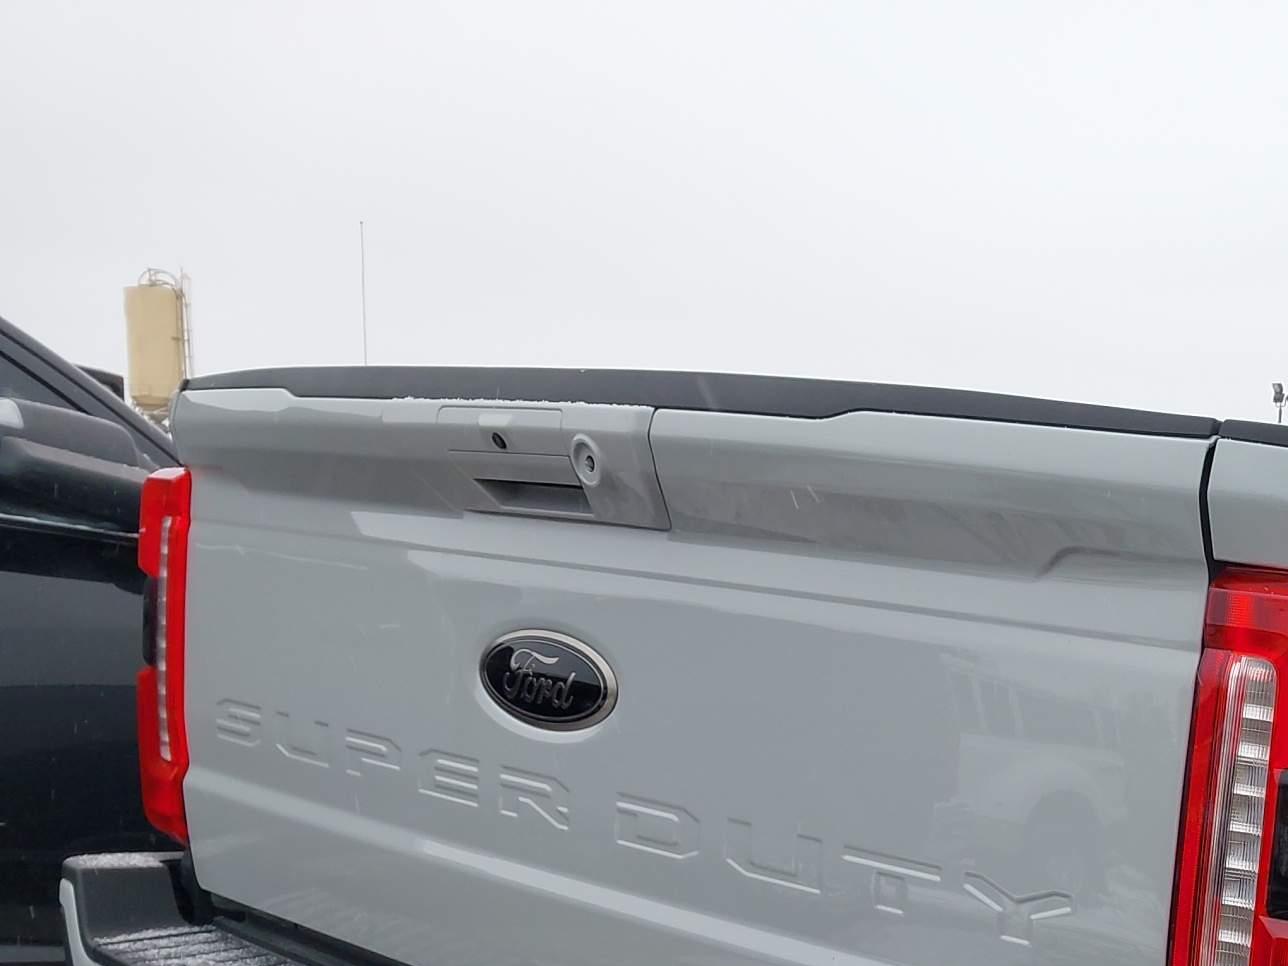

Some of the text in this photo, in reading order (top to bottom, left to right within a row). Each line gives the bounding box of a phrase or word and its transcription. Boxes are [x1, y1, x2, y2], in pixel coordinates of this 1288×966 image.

[503, 648, 577, 710] Ford
[216, 698, 1074, 947] SUPER DUTY
